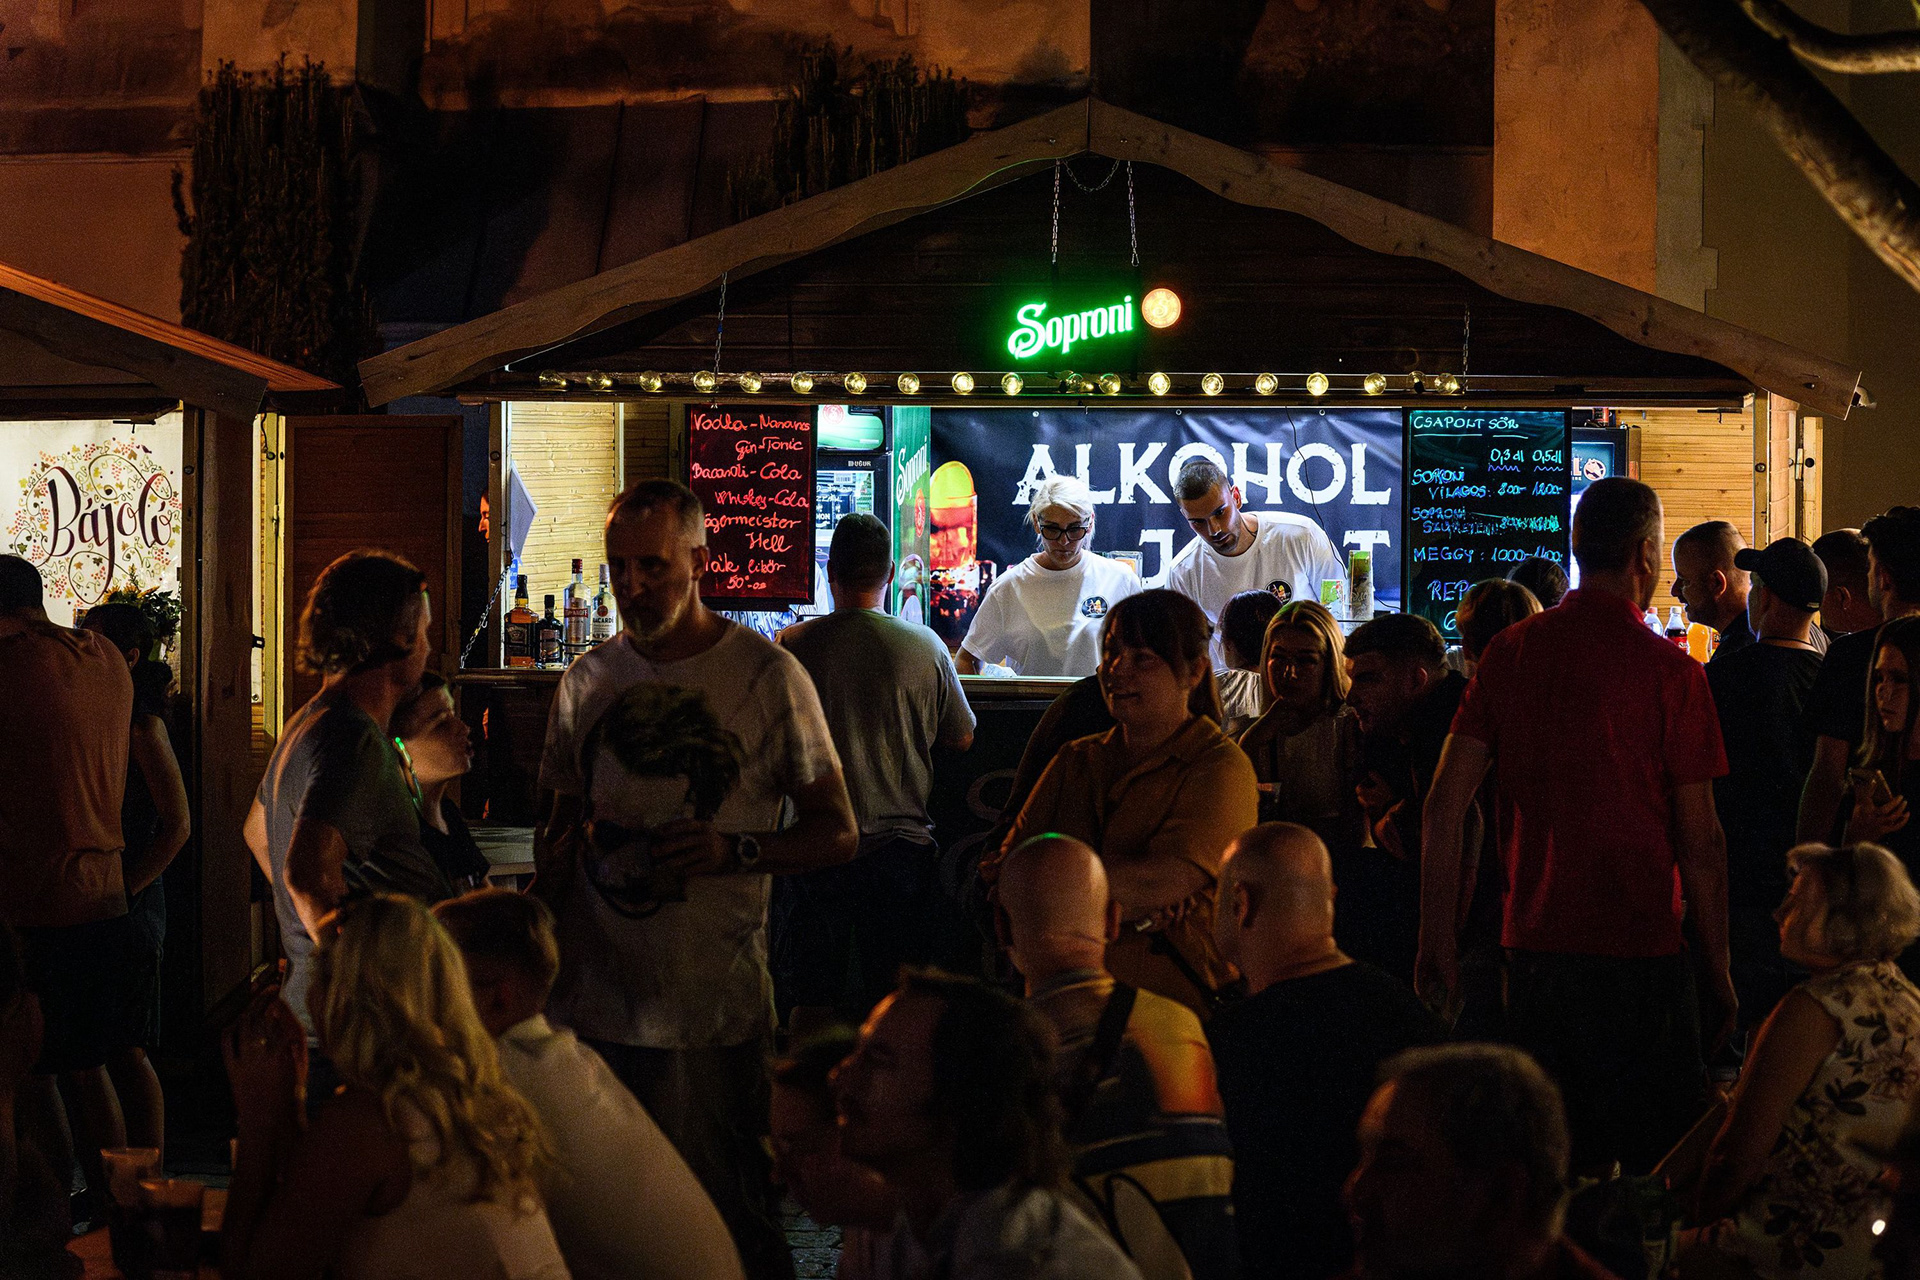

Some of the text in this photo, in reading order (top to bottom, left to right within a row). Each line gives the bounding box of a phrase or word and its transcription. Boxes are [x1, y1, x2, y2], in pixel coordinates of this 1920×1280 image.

[1008, 295, 1133, 360] Soproni
[1488, 416, 1519, 430] SÖR
[896, 436, 928, 506] Soproni
[1012, 442, 1392, 505] ALKOHOL
[27, 455, 175, 605] Bájoló
[704, 512, 802, 533] ägermeister
[745, 532, 793, 553] Hell
[705, 552, 740, 573] ák
